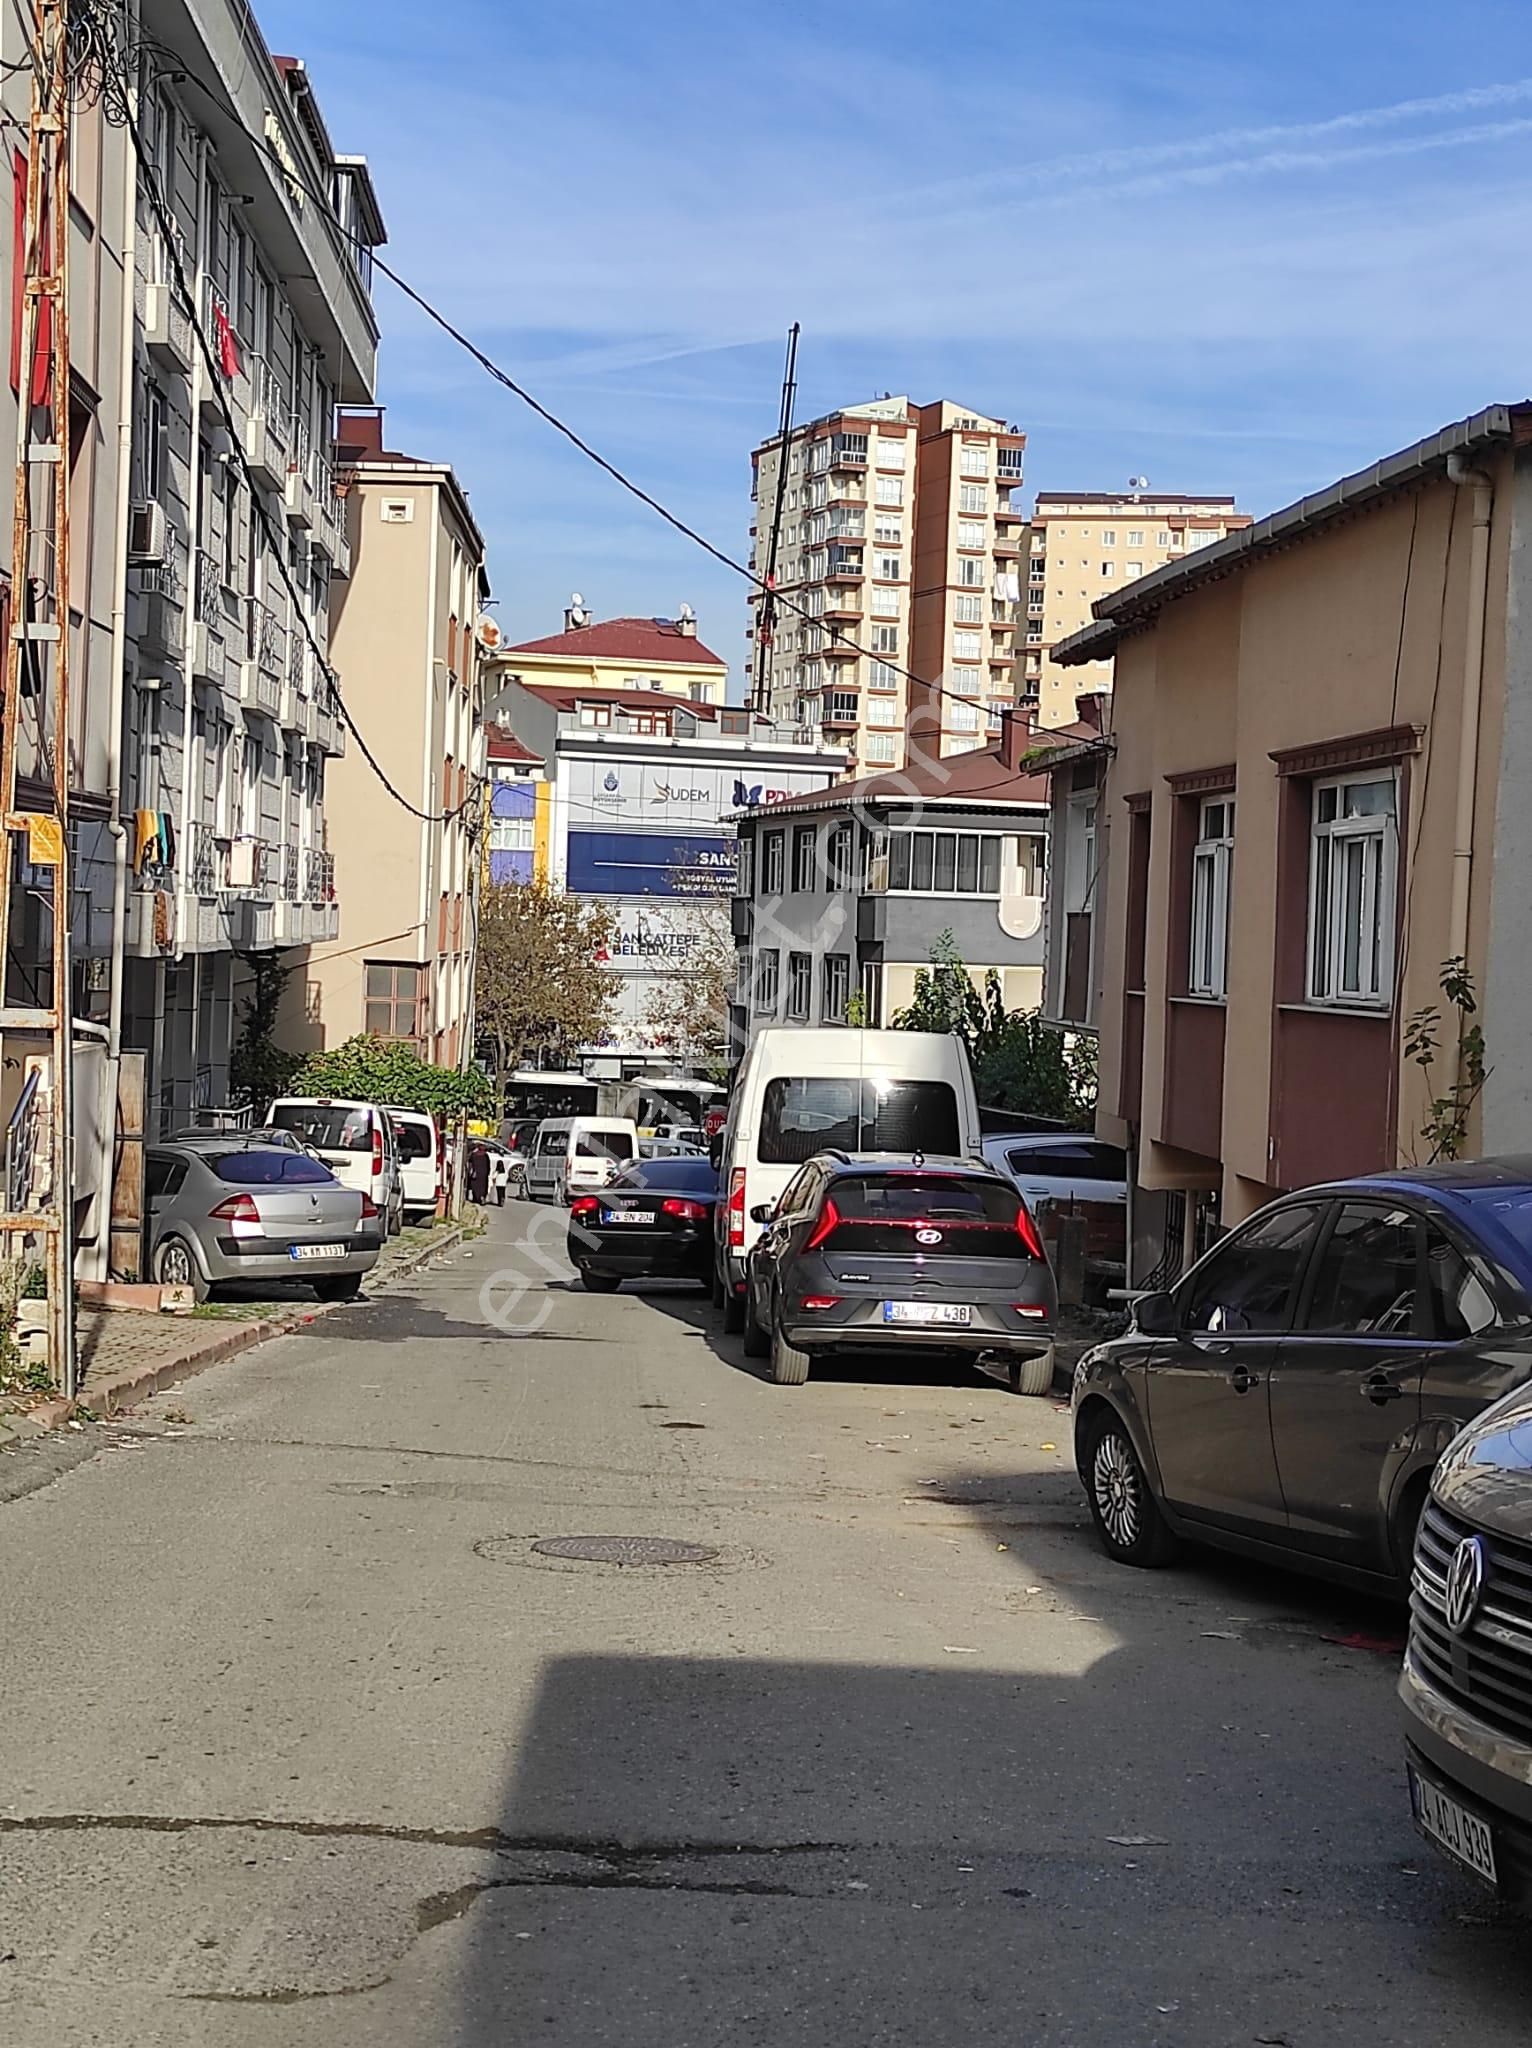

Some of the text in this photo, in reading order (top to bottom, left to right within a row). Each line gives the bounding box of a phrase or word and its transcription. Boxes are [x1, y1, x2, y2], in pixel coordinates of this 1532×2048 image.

[707, 1119, 726, 1129] DU
[943, 1306, 967, 1321] 438
[1463, 1813, 1492, 1874] 939
